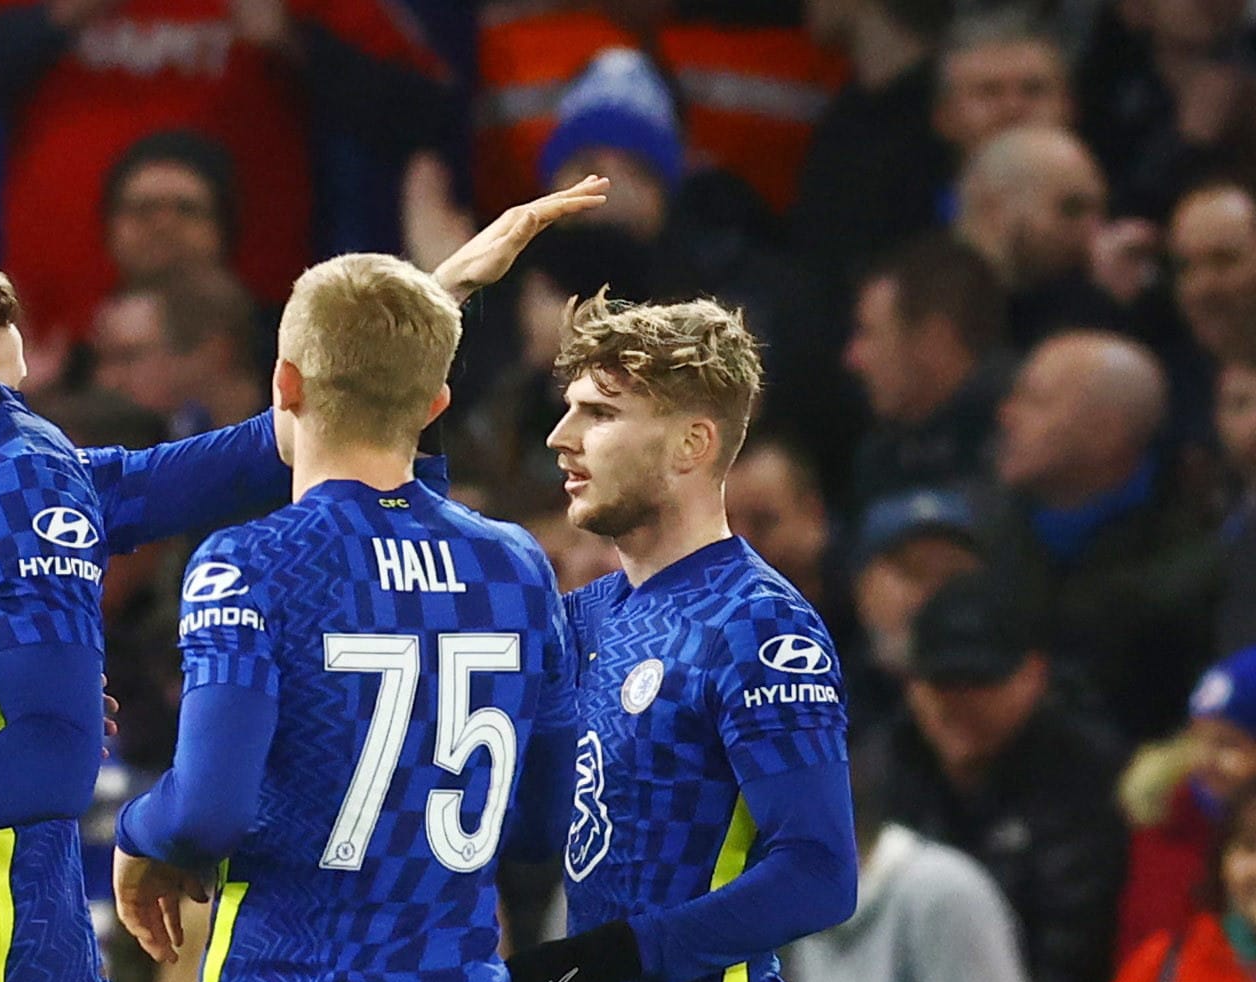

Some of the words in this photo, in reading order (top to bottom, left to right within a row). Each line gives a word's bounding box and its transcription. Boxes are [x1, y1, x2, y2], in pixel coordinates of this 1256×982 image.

[18, 556, 103, 586] HYUNDA
[372, 537, 466, 593] HALL
[743, 683, 840, 708] HYUNDA
[319, 633, 520, 872] 75
